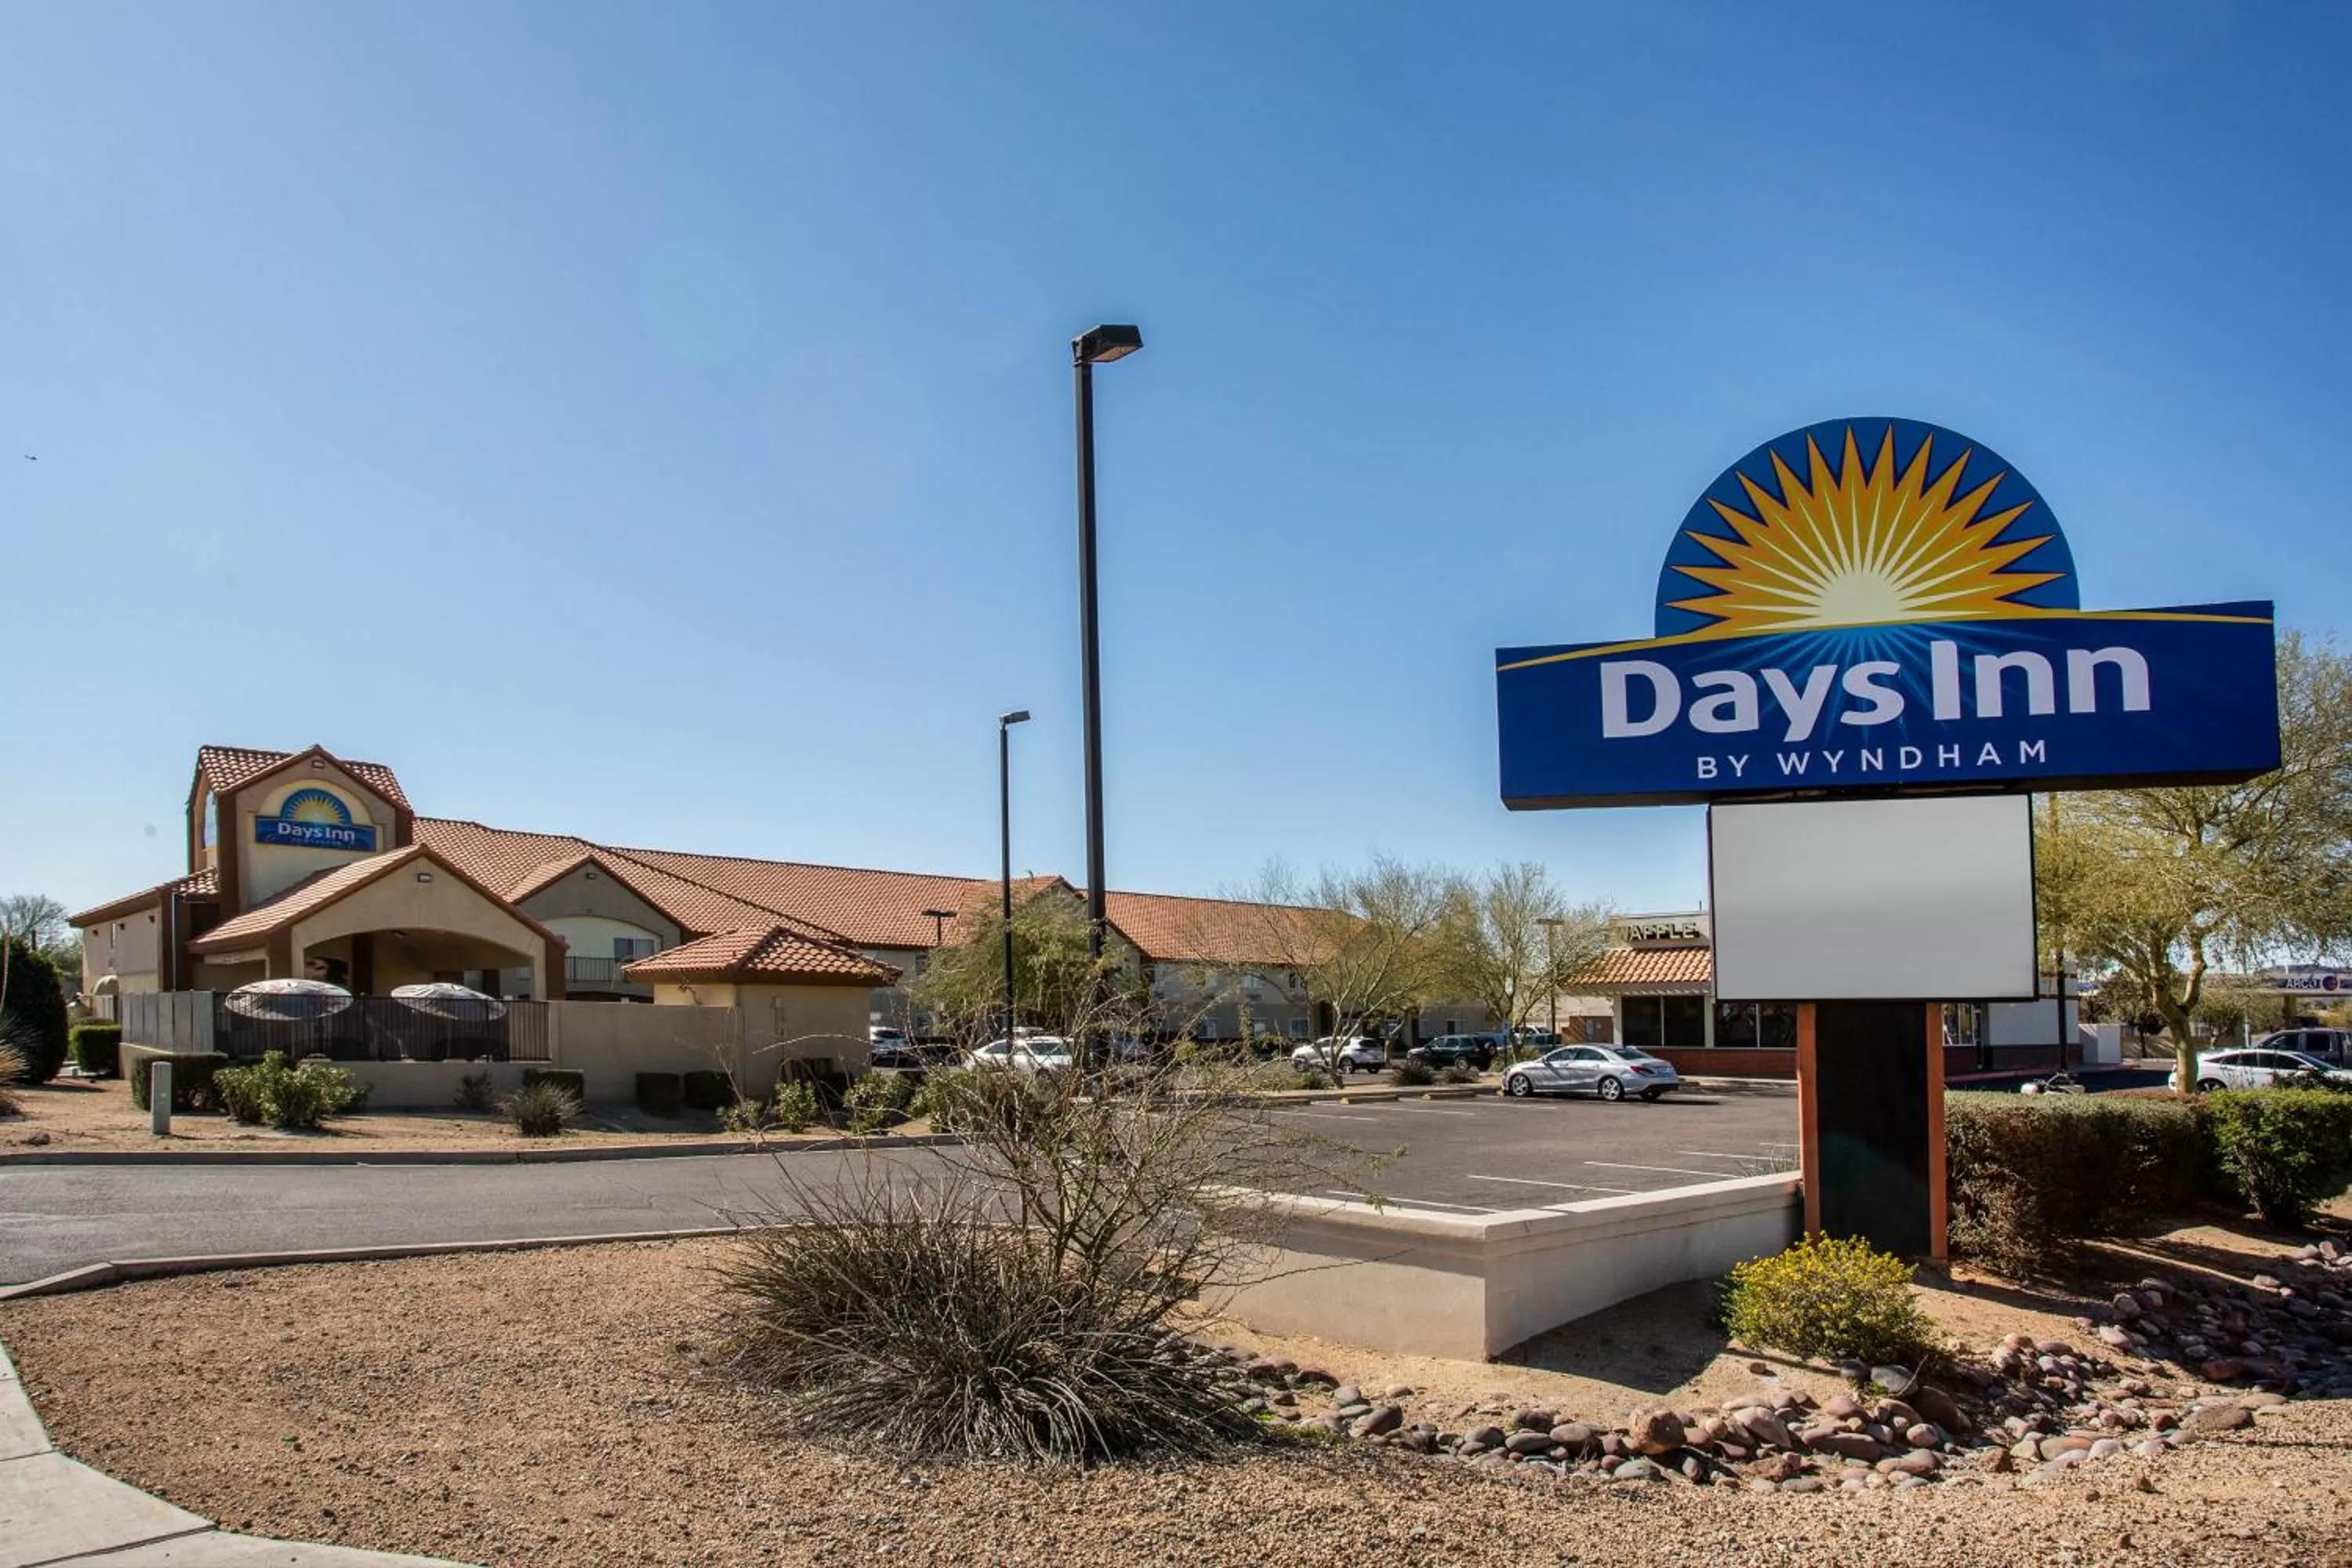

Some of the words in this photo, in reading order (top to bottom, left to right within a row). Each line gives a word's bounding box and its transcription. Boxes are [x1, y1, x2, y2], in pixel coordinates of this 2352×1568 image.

[1602, 661, 1904, 742] Days
[1932, 641, 2150, 720] Inn
[1698, 755, 1748, 779] BY
[1777, 739, 2045, 775] WYNDHAM
[278, 822, 323, 838] Days
[325, 827, 355, 842] Inn
